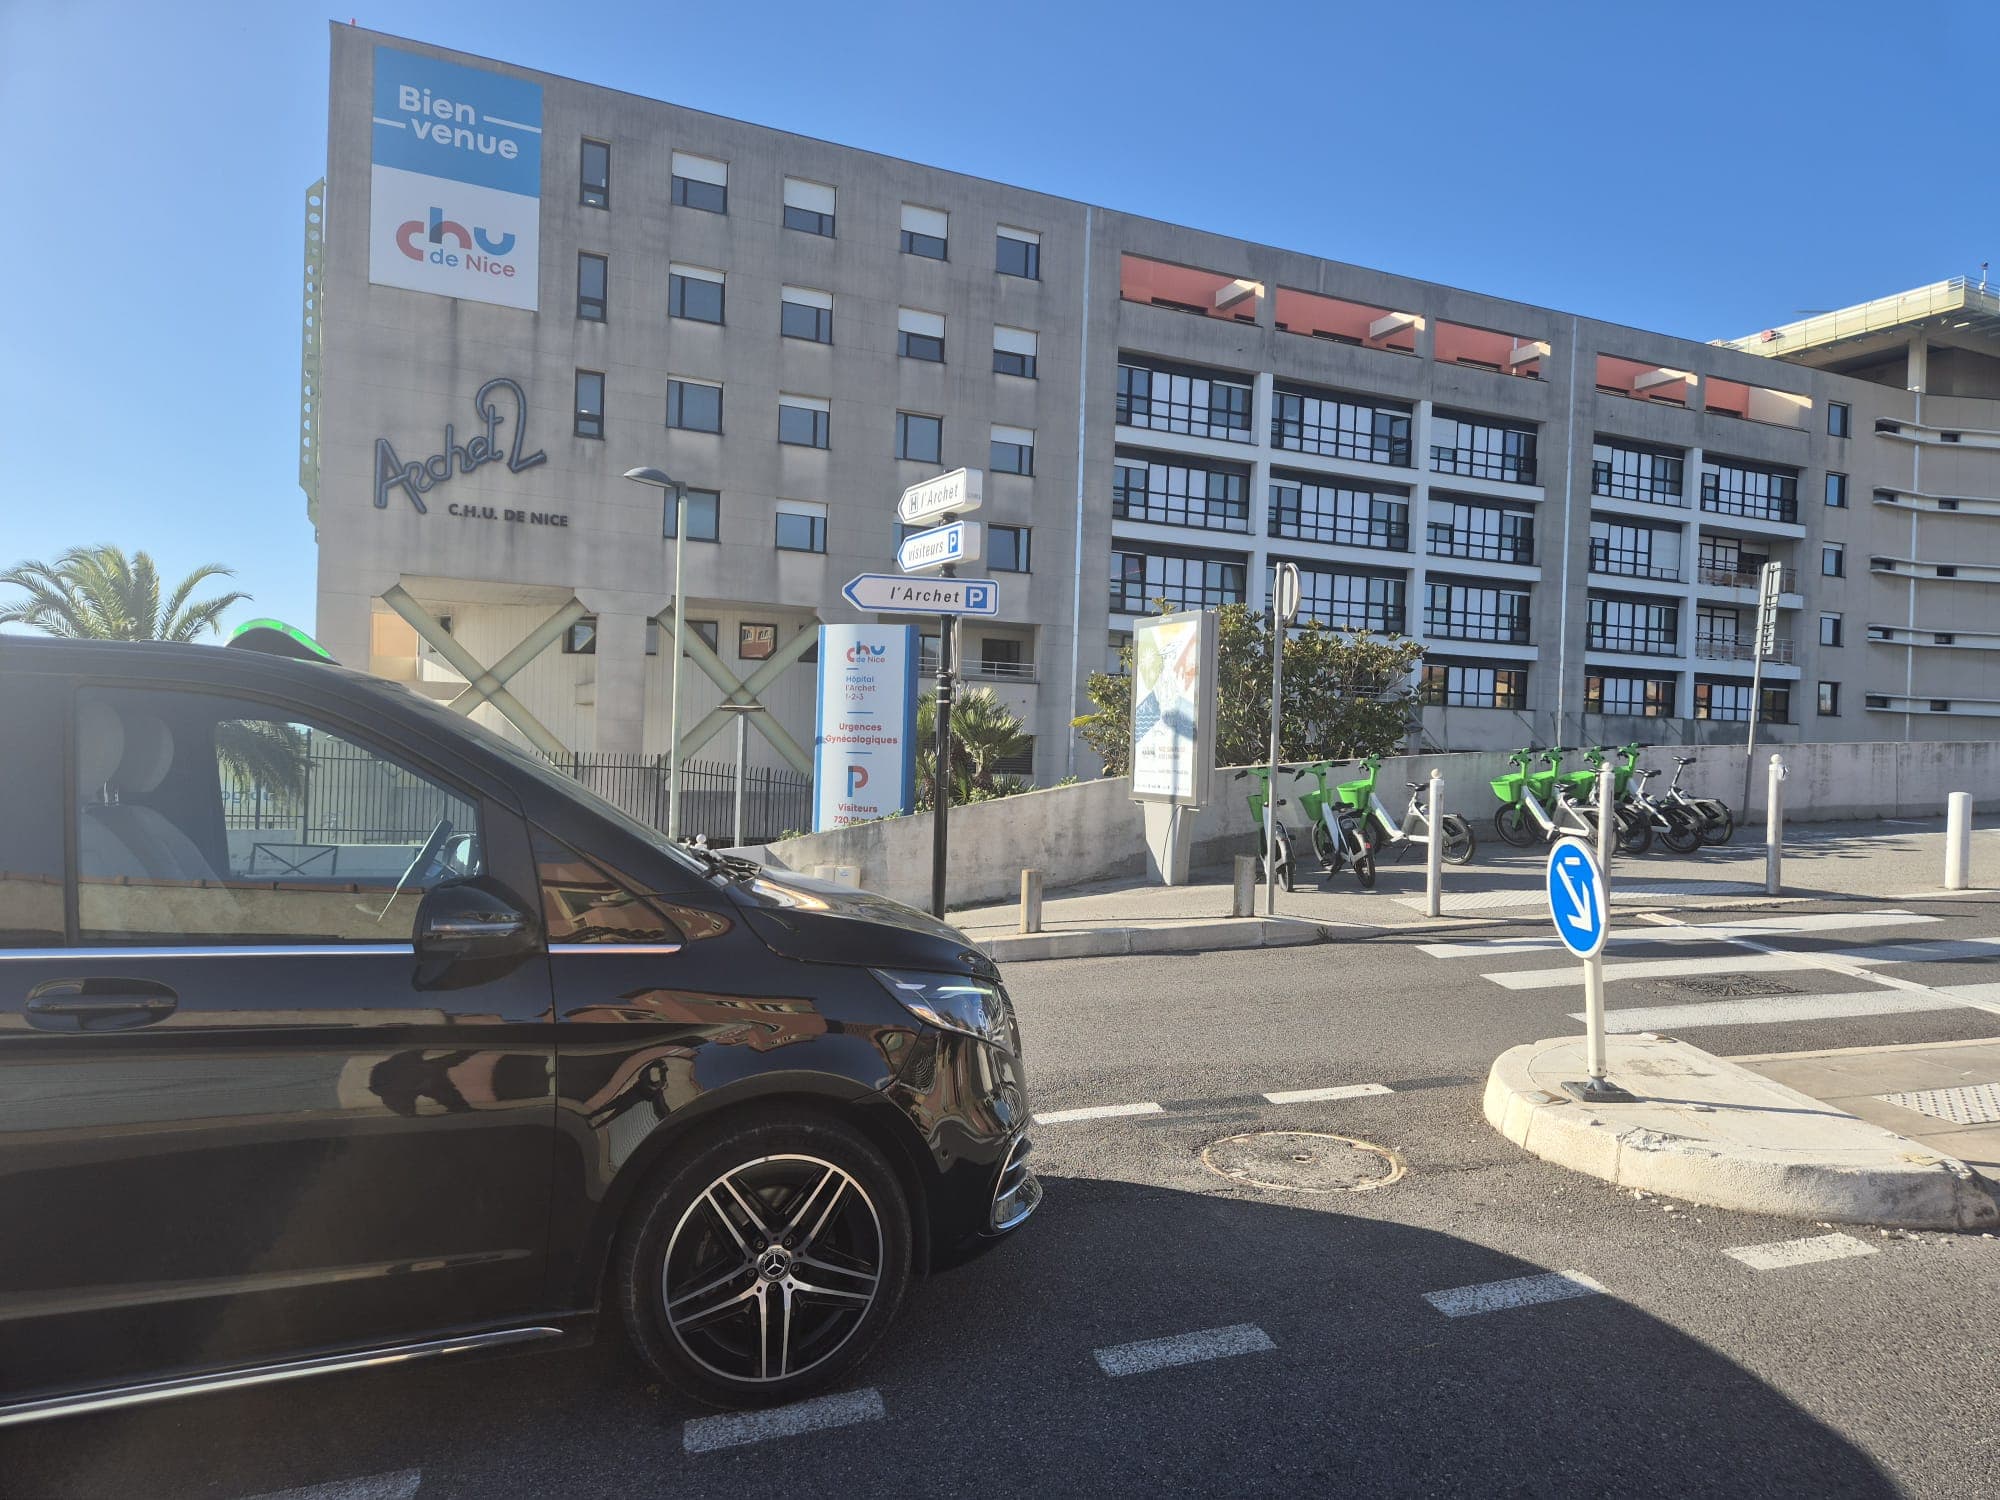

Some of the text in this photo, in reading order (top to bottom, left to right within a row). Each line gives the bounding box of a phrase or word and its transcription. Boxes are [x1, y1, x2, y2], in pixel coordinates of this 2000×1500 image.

[399, 84, 476, 126] Bien
[411, 118, 519, 160] venue
[396, 206, 516, 262] chu
[429, 247, 516, 277] de Nice
[373, 377, 548, 515] Archet 2
[920, 484, 959, 508] l'Archet
[448, 503, 569, 528] C.H.U. DE NICE
[908, 541, 945, 562] visiteurs
[890, 587, 984, 607] l'Archet P
[847, 641, 885, 662] chu
[856, 655, 866, 663] de
[839, 722, 882, 732] Urgences
[826, 735, 898, 745] Gynécologiques
[848, 766, 869, 797] P
[838, 803, 878, 813] Visiteurs
[834, 816, 849, 824] 720
